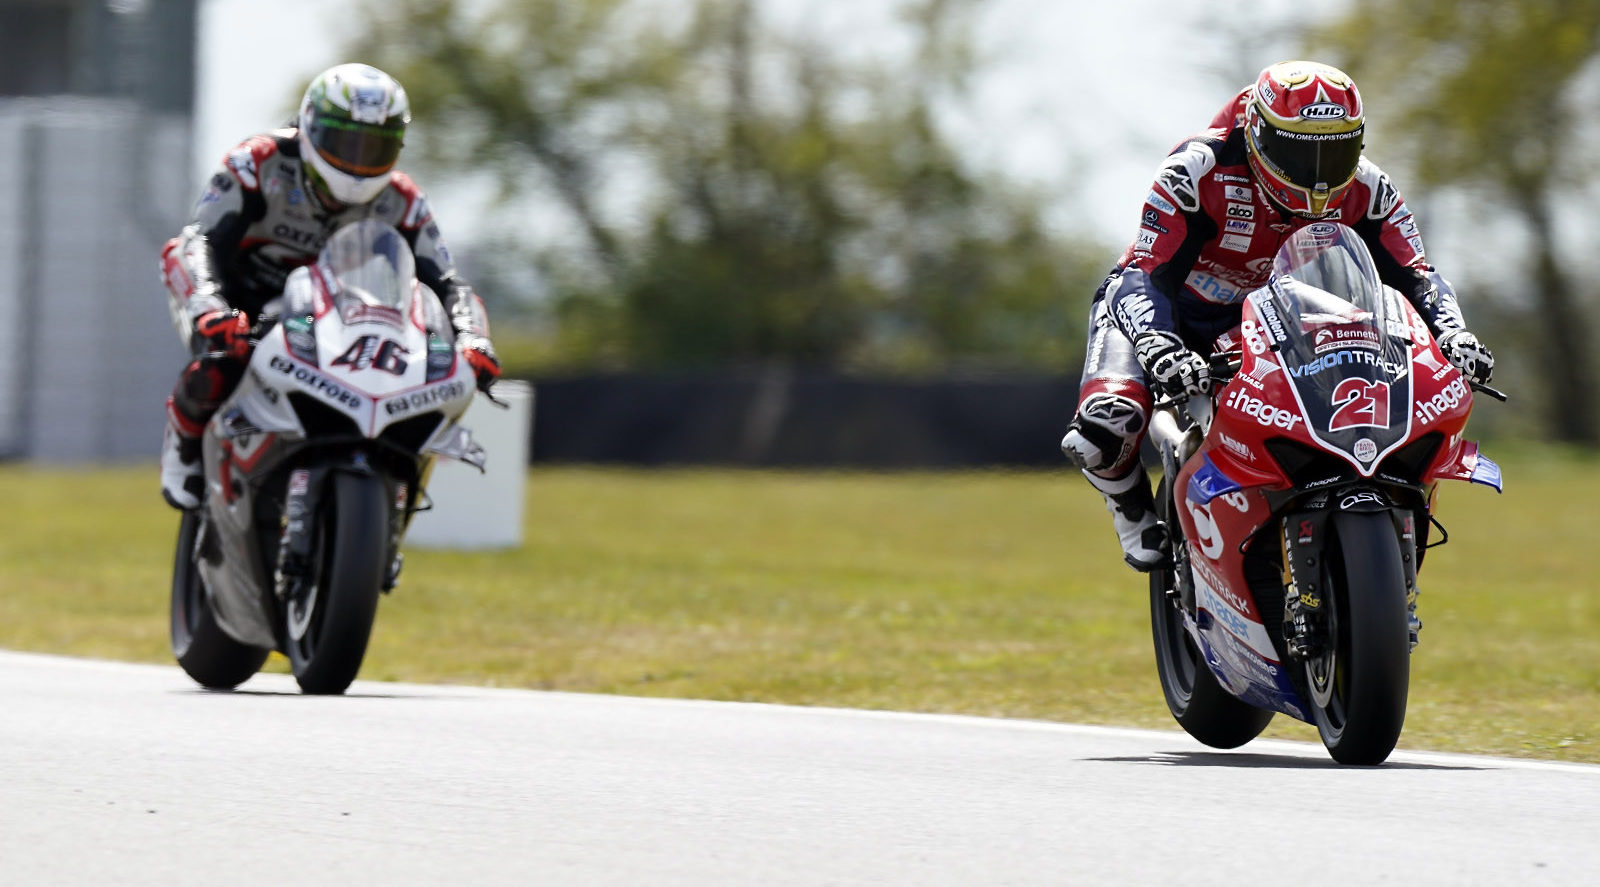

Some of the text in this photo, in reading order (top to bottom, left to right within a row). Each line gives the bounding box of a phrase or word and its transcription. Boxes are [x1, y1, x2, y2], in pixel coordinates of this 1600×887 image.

[1305, 107, 1342, 117] HJC
[1192, 273, 1235, 302] :ha
[1260, 300, 1287, 342] Silkolene
[1336, 329, 1379, 341] Bennetts
[330, 334, 410, 376] 46
[1289, 350, 1406, 378] VISIONTRACK
[295, 368, 362, 409] OXFORD
[1238, 371, 1265, 390] YUASA
[1415, 375, 1468, 425] :hager
[1226, 387, 1303, 431] :hager
[1328, 376, 1391, 433] 21
